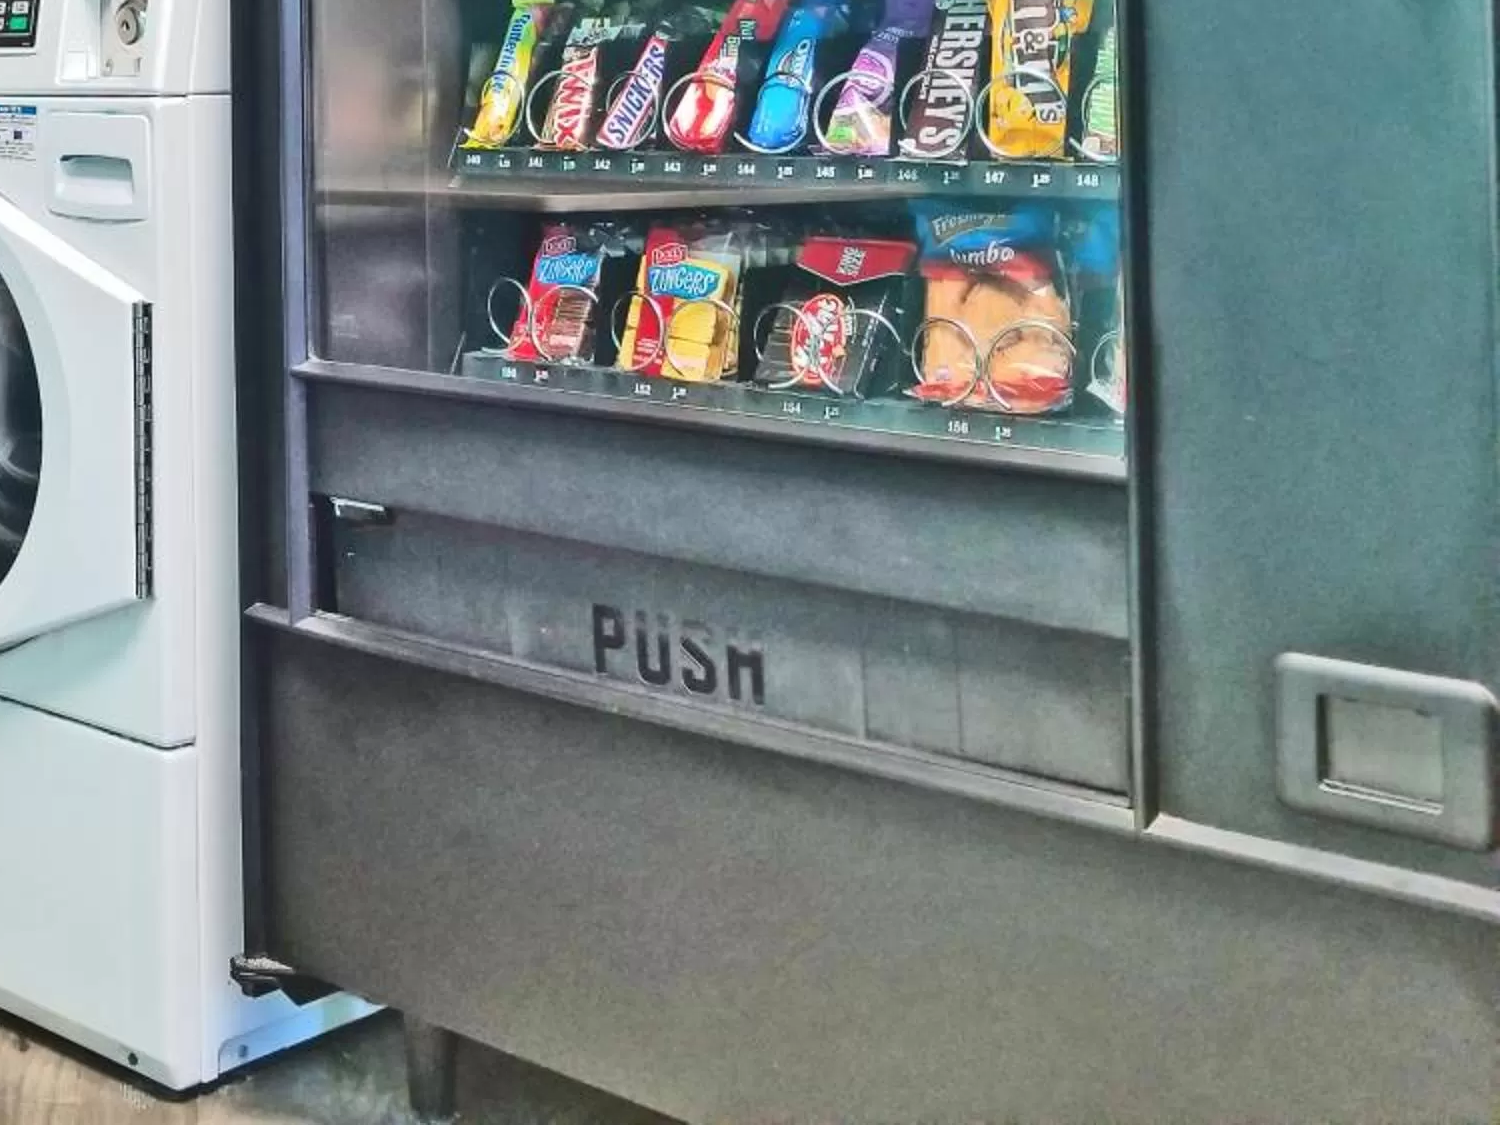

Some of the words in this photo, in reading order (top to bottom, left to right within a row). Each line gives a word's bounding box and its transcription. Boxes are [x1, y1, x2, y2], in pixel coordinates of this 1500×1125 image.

[607, 44, 666, 143] SNICKERS
[650, 266, 716, 295] ZINGERS
[592, 602, 766, 706] PUSH
